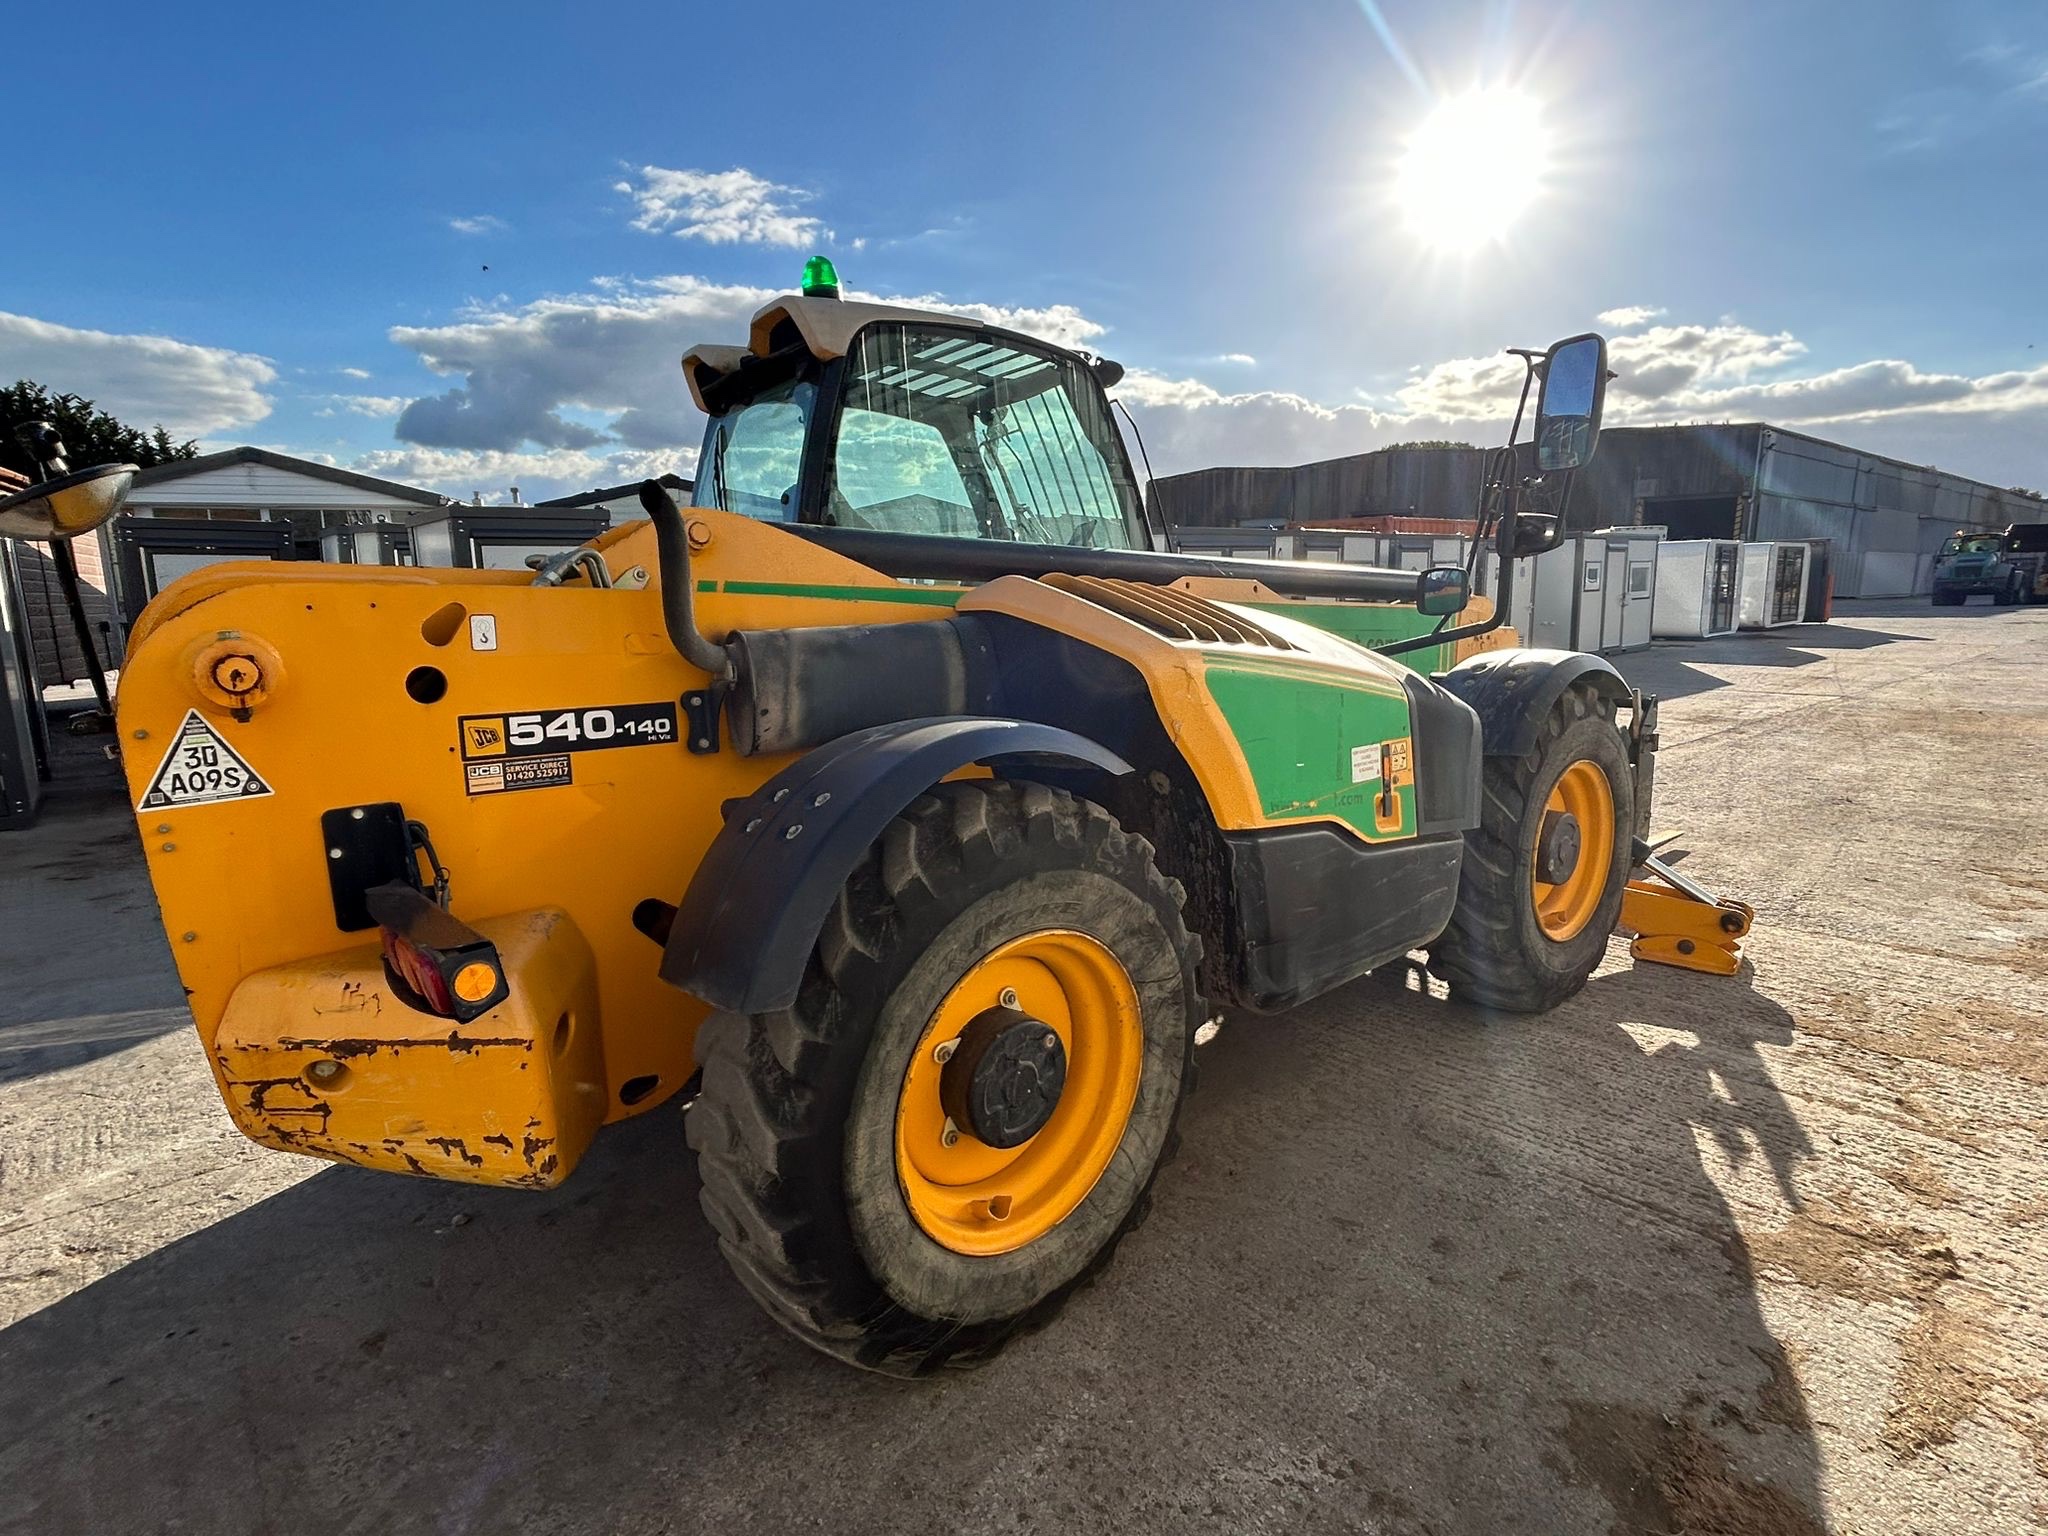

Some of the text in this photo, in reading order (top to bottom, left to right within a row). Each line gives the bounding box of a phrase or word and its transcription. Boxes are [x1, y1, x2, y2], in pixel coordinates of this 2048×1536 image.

[508, 709, 671, 746] 540-140
[475, 729, 499, 746] JCB
[471, 766, 500, 777] JCB
[505, 763, 539, 773] SERVICE
[540, 760, 568, 770] DIRECT
[506, 770, 535, 781] 01420
[537, 767, 568, 778] 525917
